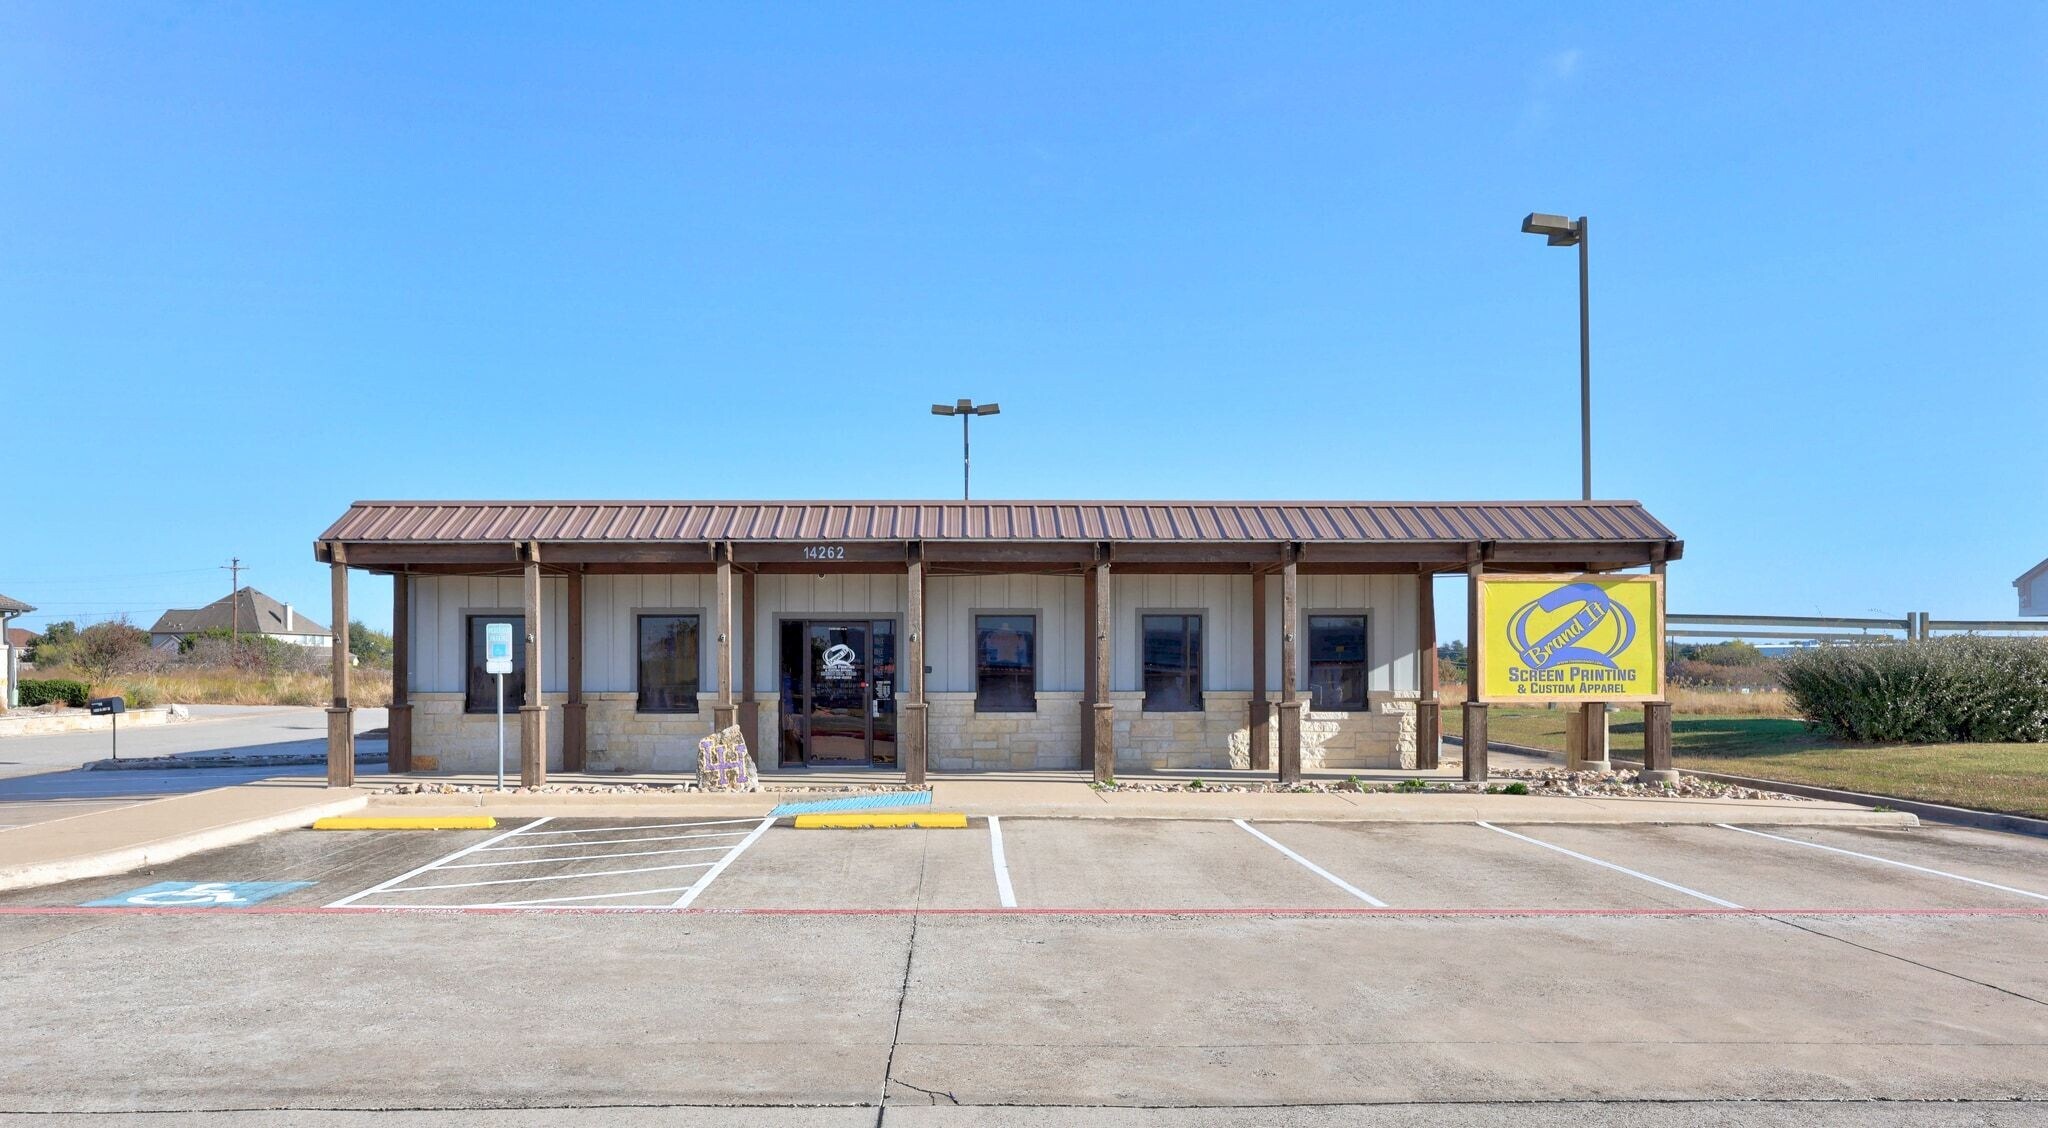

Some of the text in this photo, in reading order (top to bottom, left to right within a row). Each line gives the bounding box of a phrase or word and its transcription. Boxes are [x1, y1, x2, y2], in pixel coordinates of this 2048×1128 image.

[803, 546, 844, 559] 14262
[1523, 602, 1606, 668] Brand It
[1509, 666, 1636, 682] SCREEN PRINTING
[1517, 682, 1626, 694] & CUSTOM APPAREL
